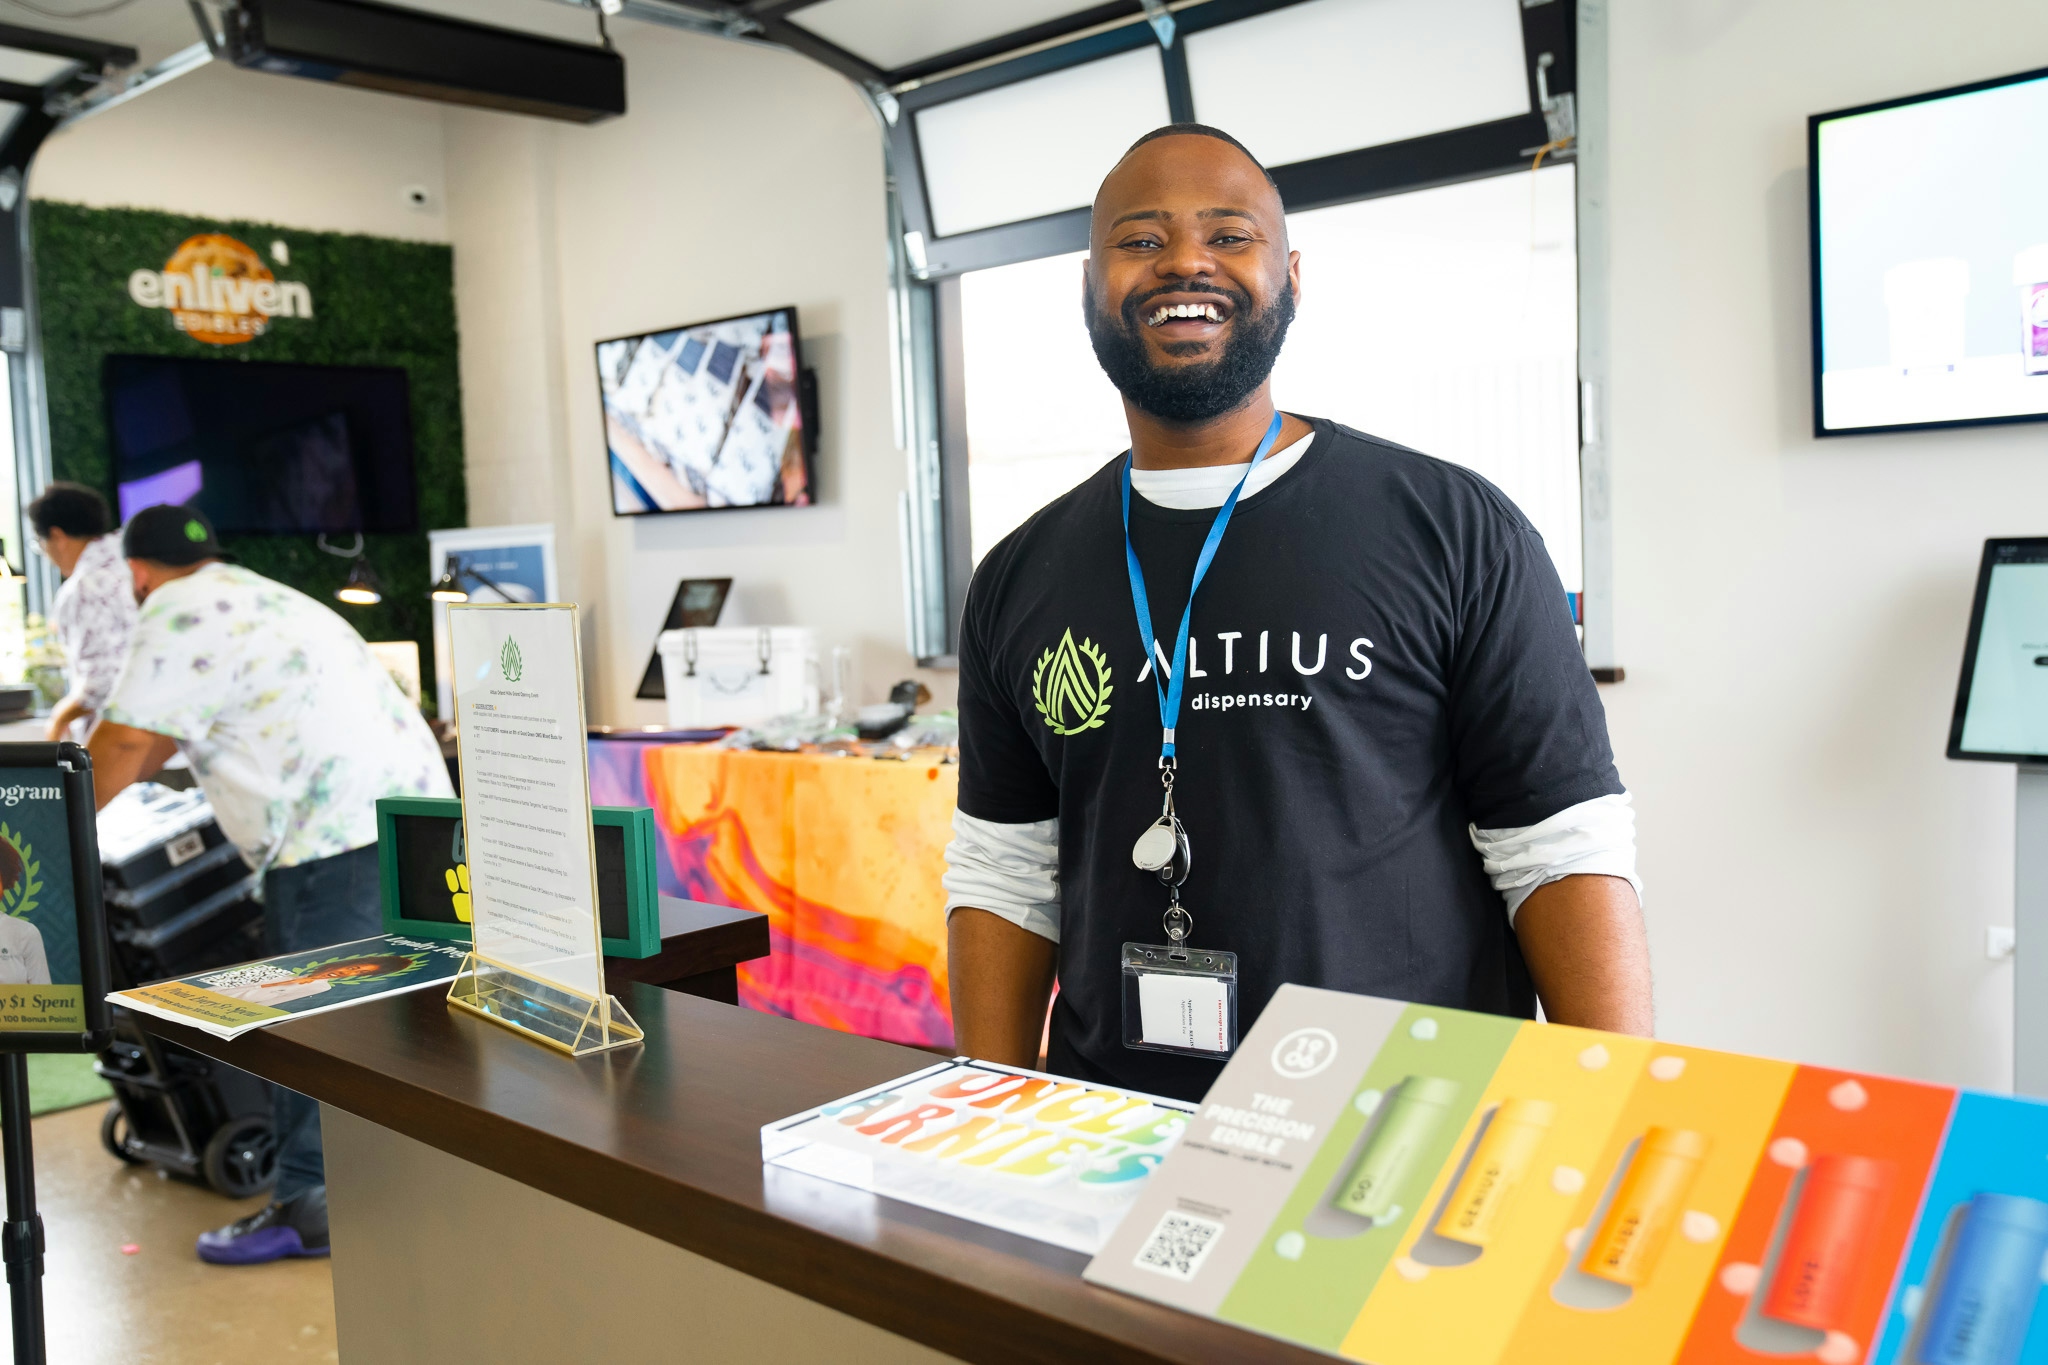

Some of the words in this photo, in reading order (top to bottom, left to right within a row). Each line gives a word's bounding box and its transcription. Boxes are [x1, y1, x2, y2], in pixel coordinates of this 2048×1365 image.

[128, 262, 313, 319] enliven
[173, 311, 266, 336] EDIBLES
[1136, 630, 1375, 683] ALTIUS
[1191, 692, 1313, 712] dispensary
[9, 994, 26, 1011] $1
[32, 993, 76, 1012] Spent
[167, 987, 191, 999] Point
[190, 995, 215, 1008] Every
[226, 1005, 264, 1018] Spent
[4, 1014, 18, 1023] 100
[21, 1014, 47, 1023] Bonus
[49, 1014, 77, 1023] Points!
[928, 1074, 1192, 1146] UNCLE
[1251, 1092, 1294, 1117] THE
[1203, 1103, 1316, 1142] PRECISION
[1209, 1125, 1286, 1156] EDIBLE
